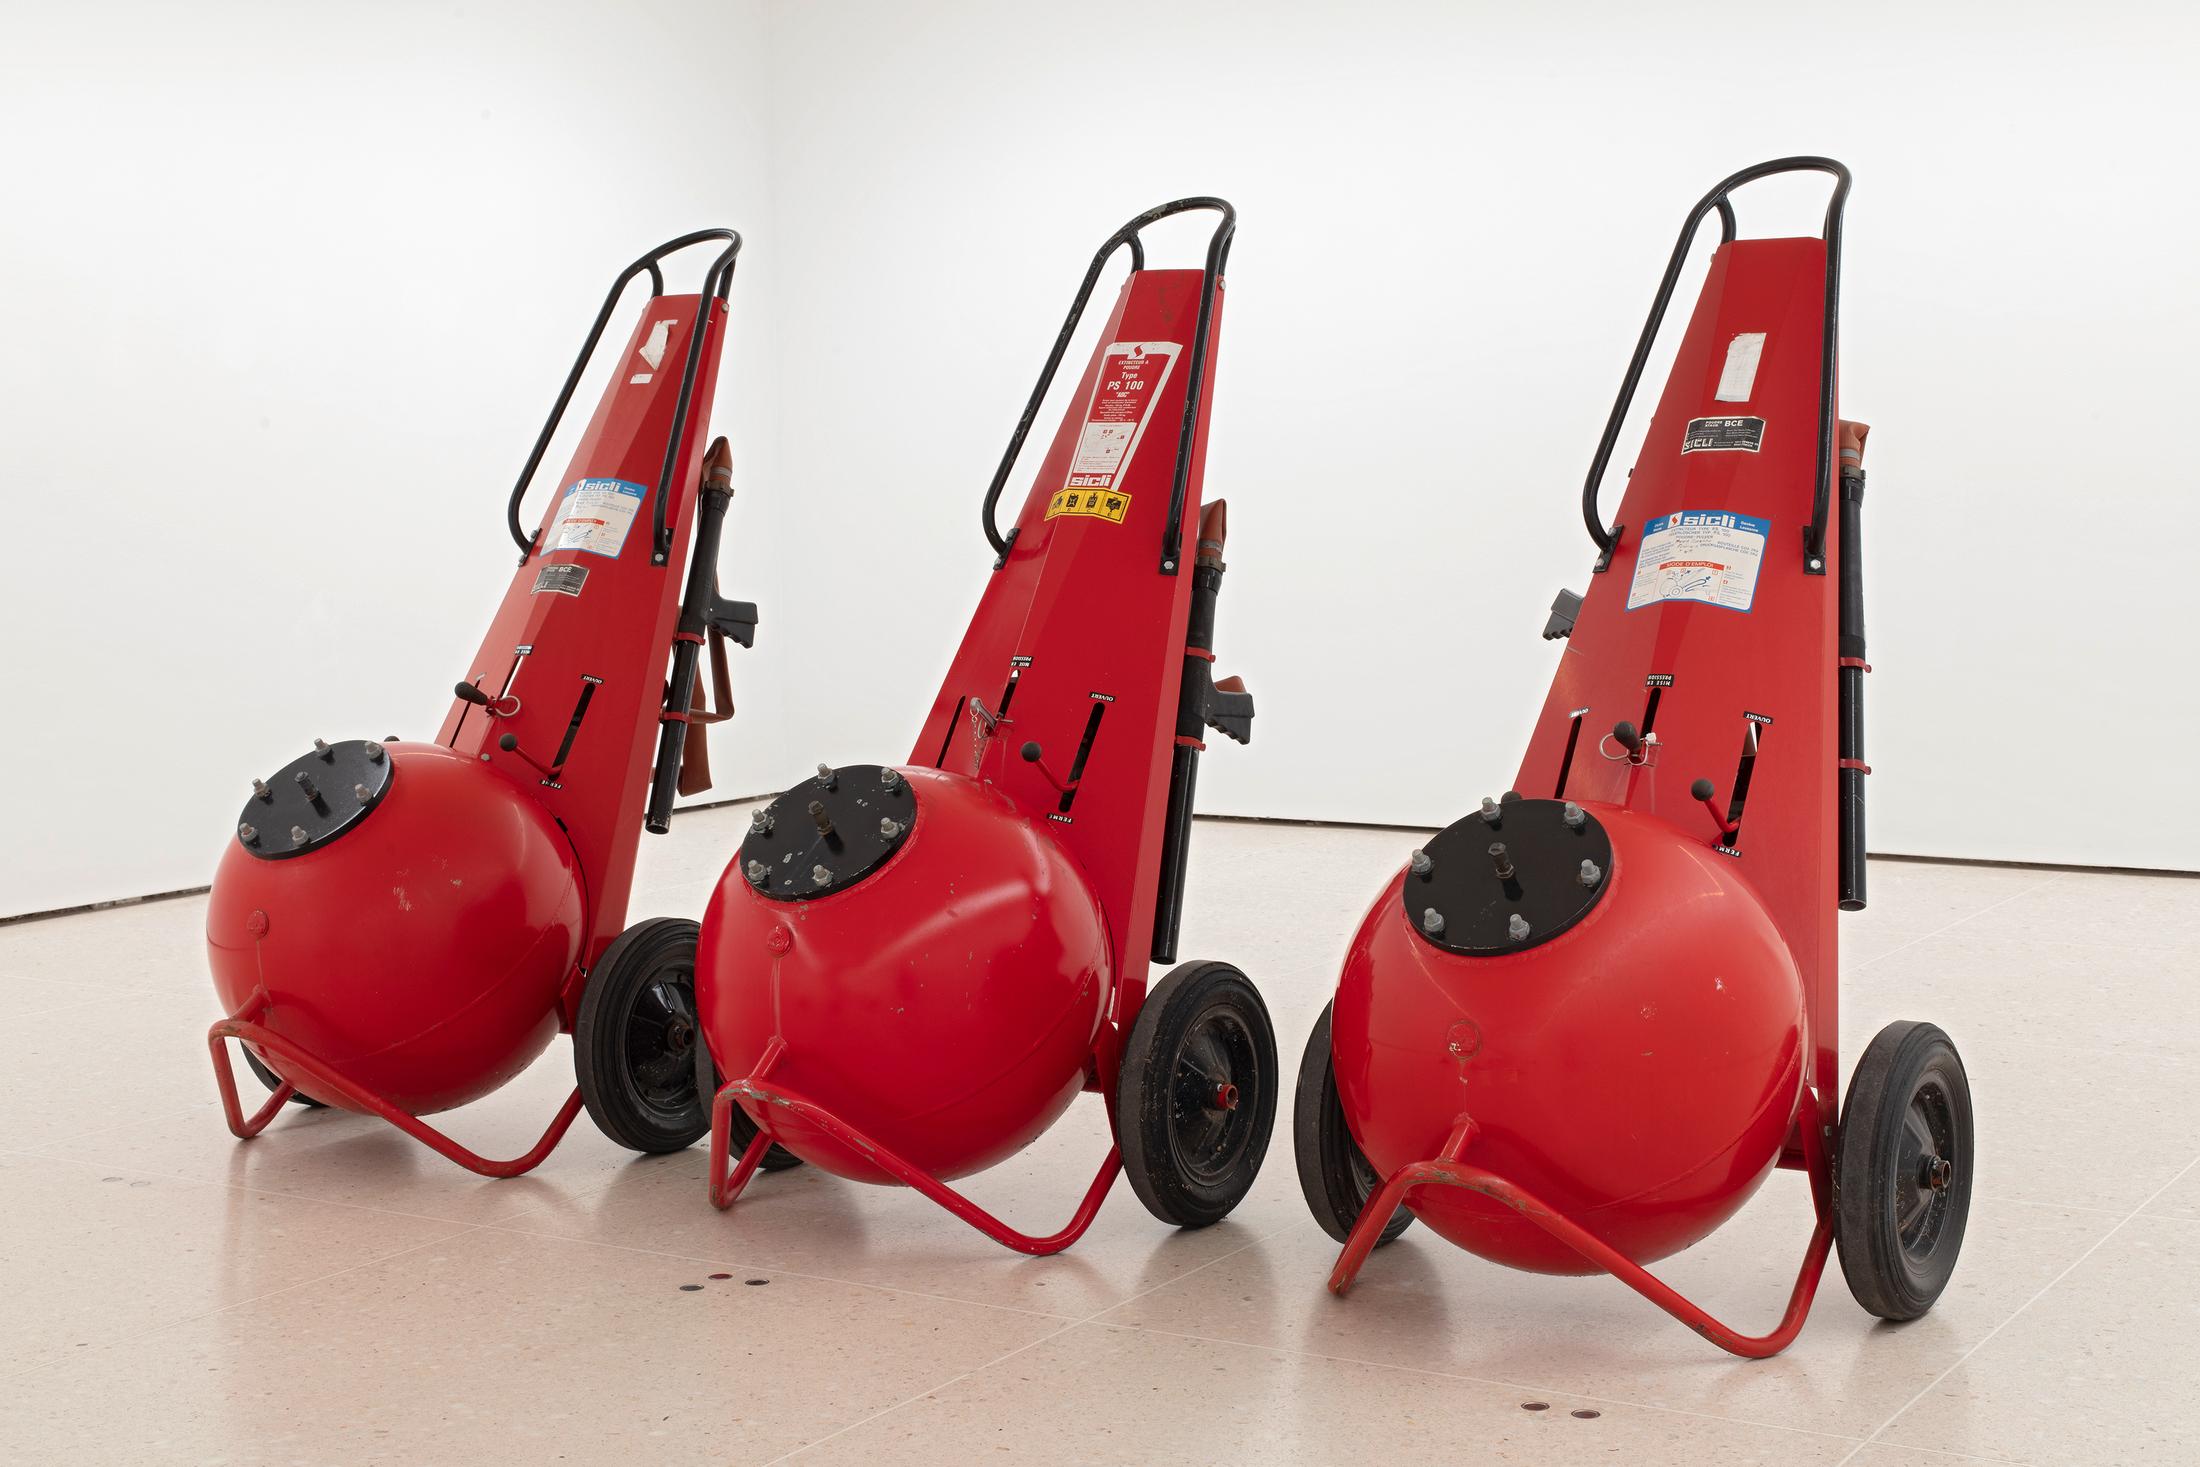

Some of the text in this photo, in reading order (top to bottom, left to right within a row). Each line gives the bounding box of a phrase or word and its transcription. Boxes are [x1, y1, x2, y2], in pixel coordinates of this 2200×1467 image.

[1121, 372, 1138, 380] Type
[1107, 381, 1144, 390] PS 100
[1684, 438, 1713, 450] SICLI
[585, 481, 621, 492] sicli
[1070, 475, 1112, 487] sicli
[1683, 513, 1736, 528] sicli
[583, 676, 603, 684] OUVERT
[1090, 693, 1114, 702] OUVERT
[1746, 713, 1771, 724] OUVERT
